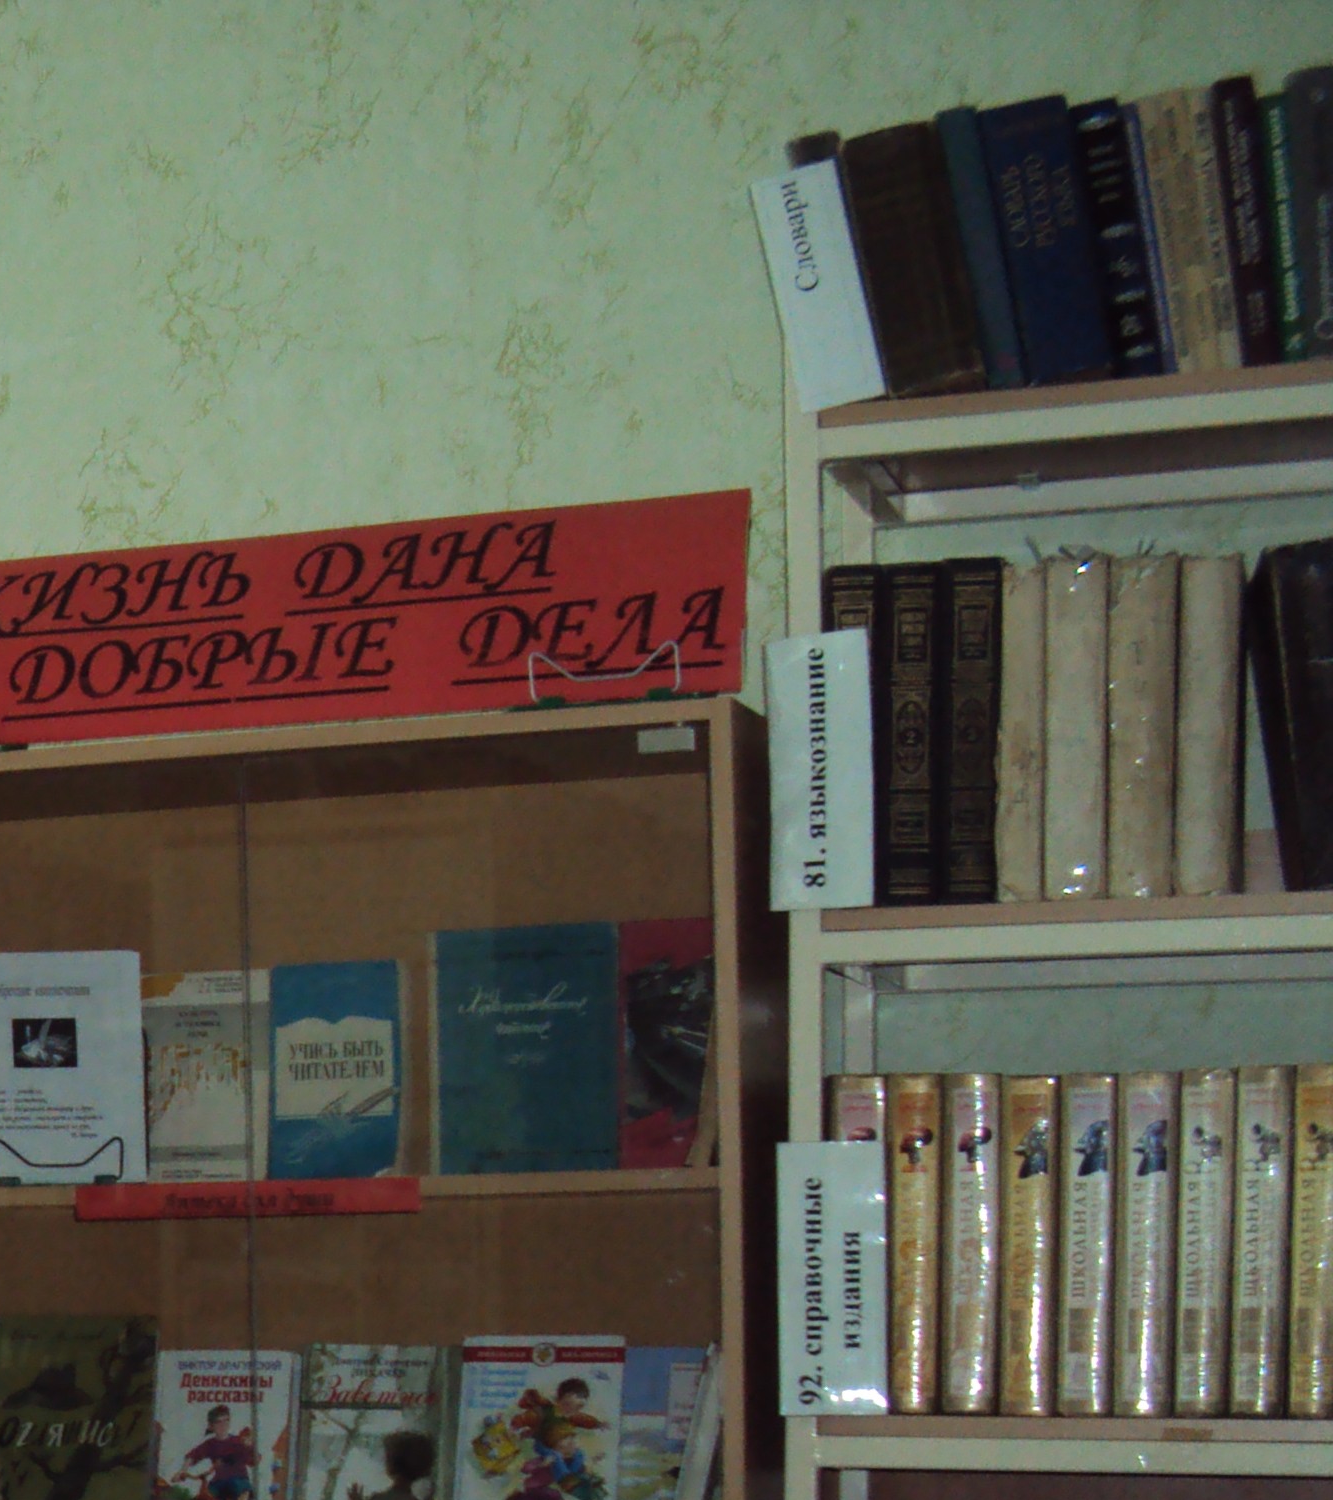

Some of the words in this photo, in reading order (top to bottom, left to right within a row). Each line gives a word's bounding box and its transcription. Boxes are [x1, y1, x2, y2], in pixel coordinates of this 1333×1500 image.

[779, 180, 819, 293] Словари
[293, 520, 556, 598] ДАНА
[9, 614, 398, 706] ДОБРЫЕ
[460, 588, 725, 669] ДЕЛА
[810, 647, 826, 839] языкознание
[803, 847, 826, 888] 81.
[287, 1041, 338, 1061] УЧИСЬ
[342, 1039, 384, 1058] БЫТЬ
[287, 1061, 385, 1082] ЧИТАТЕЛЕМ
[805, 1177, 830, 1356] справочные
[842, 1232, 864, 1349] издания
[1070, 1181, 1088, 1298] ШКОЛЬНАЯ
[1185, 1181, 1201, 1298] ШКОЛЬНАЯ
[1243, 1178, 1259, 1297] ШКОЛЬНАЯ
[798, 1366, 823, 1405] 92.
